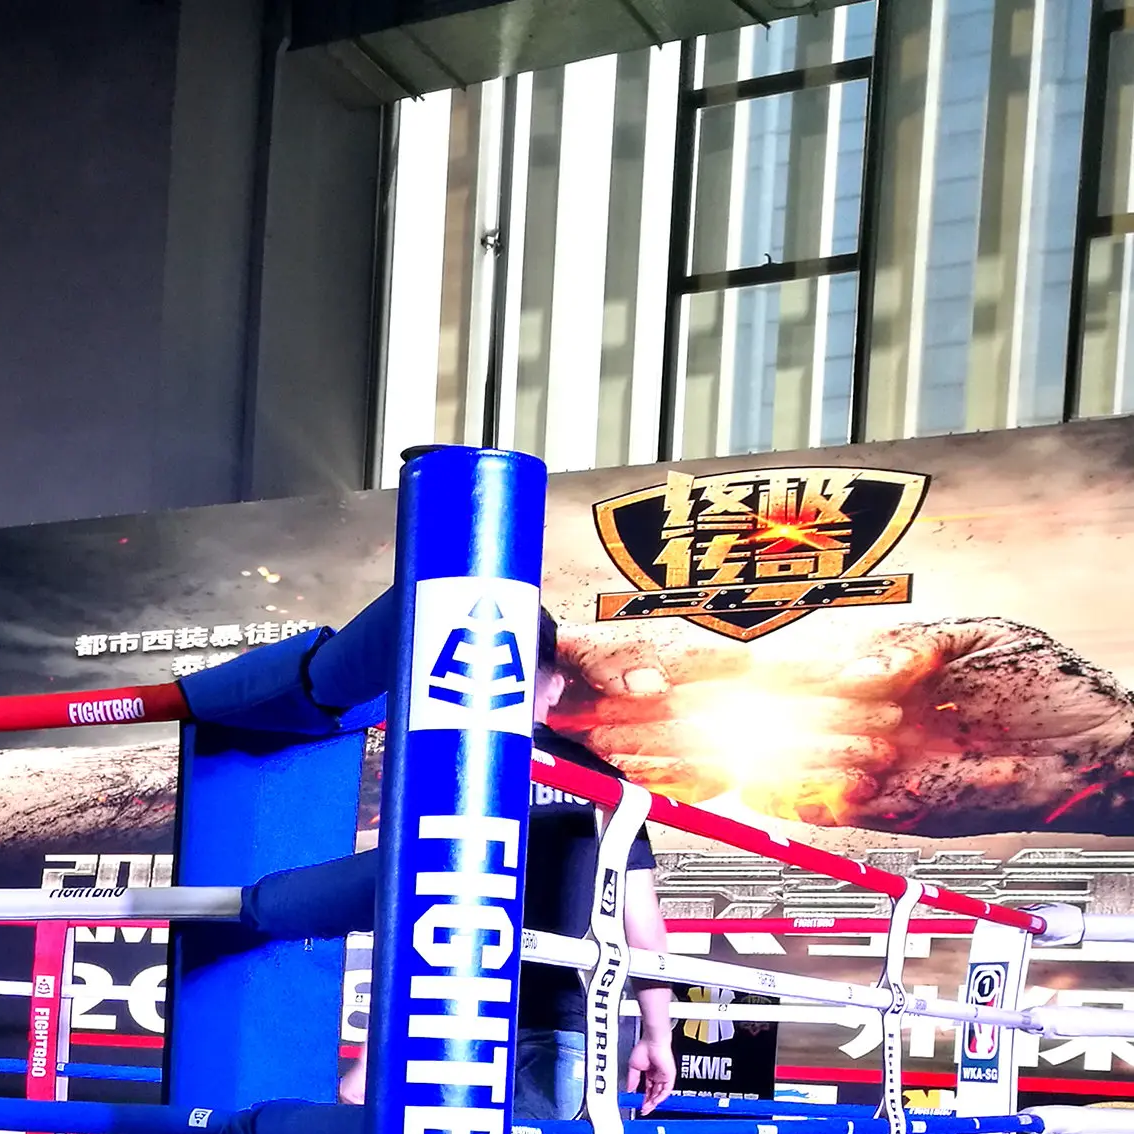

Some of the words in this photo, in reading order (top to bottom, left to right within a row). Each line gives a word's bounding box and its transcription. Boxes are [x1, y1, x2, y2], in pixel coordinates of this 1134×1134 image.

[75, 619, 317, 657] 都市西装暴徒的
[68, 696, 145, 724] FIGHTBRO
[32, 1007, 50, 1078] FIGHTBRO
[689, 1055, 733, 1081] KMC
[962, 1067, 998, 1082] WKA-SG
